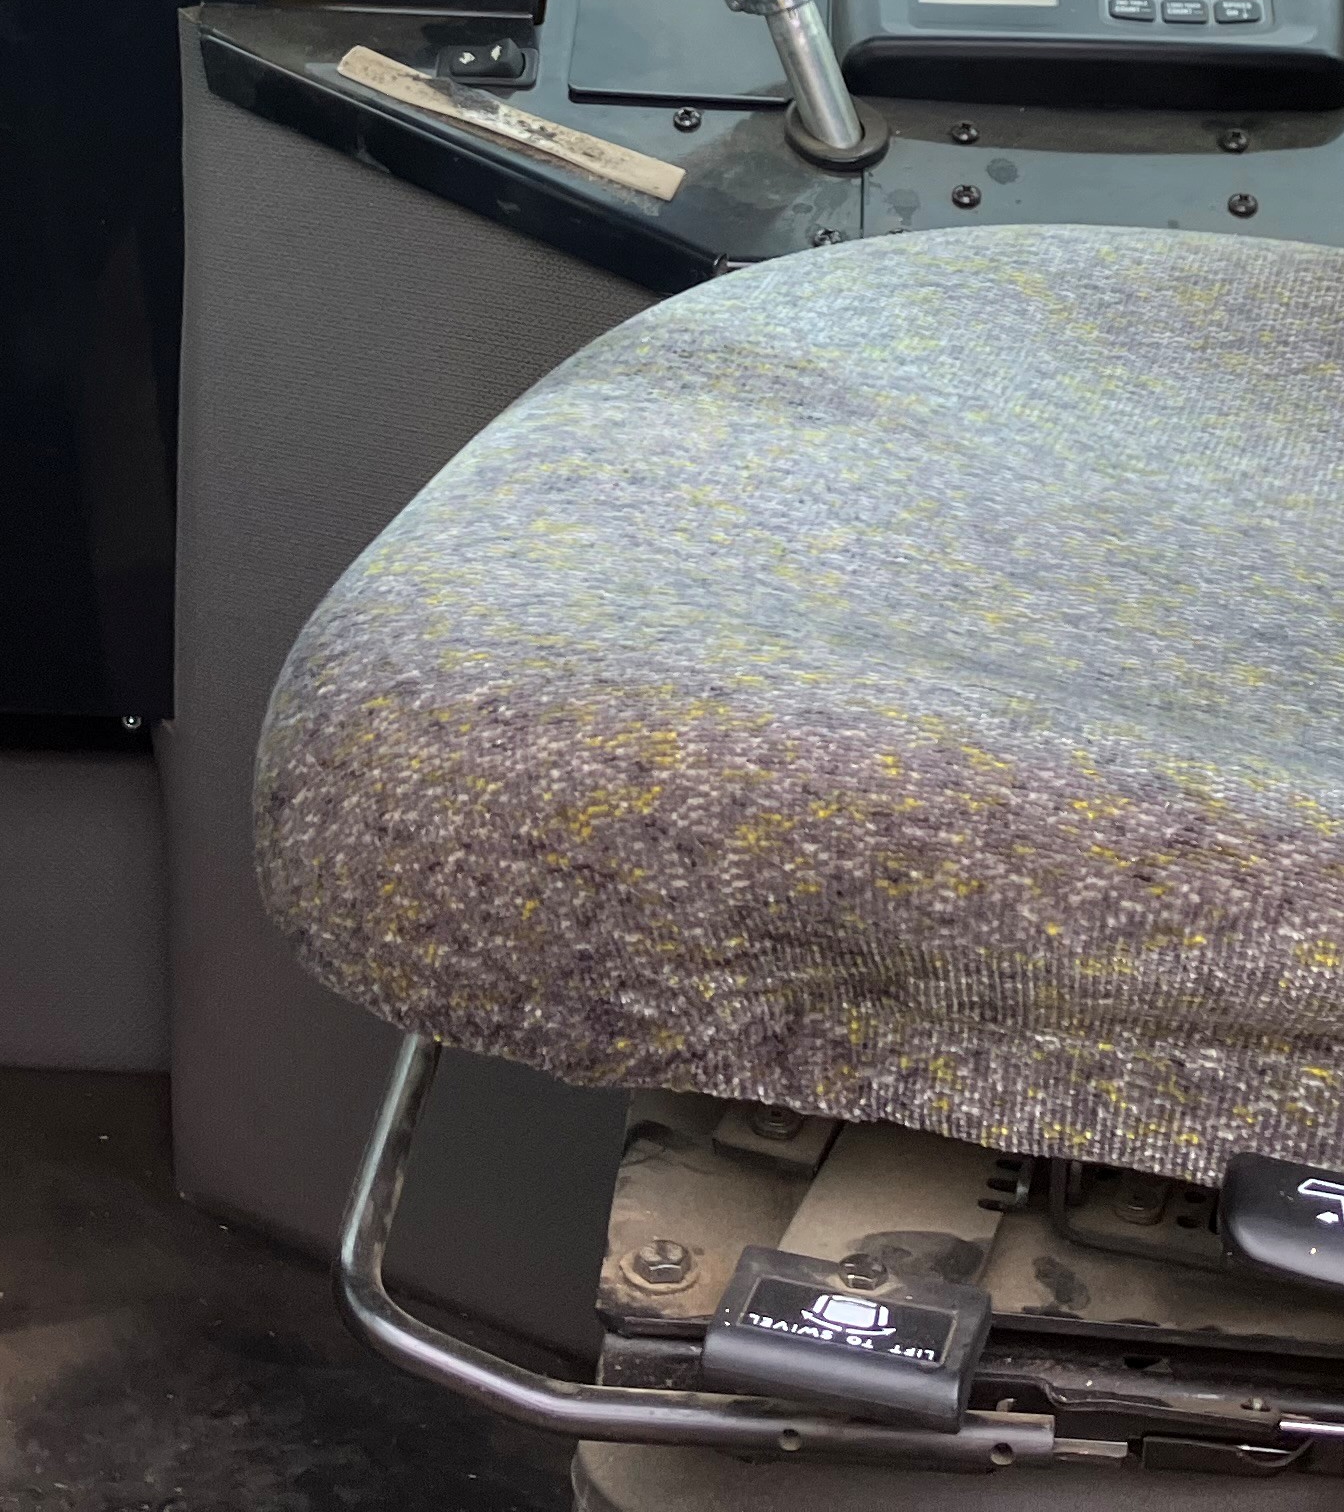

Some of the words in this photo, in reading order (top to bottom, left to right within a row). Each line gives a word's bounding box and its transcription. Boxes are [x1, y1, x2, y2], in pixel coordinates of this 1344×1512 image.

[748, 1312, 834, 1340] SWIVEL
[846, 1335, 874, 1349] TO
[889, 1344, 935, 1361] LIFT
